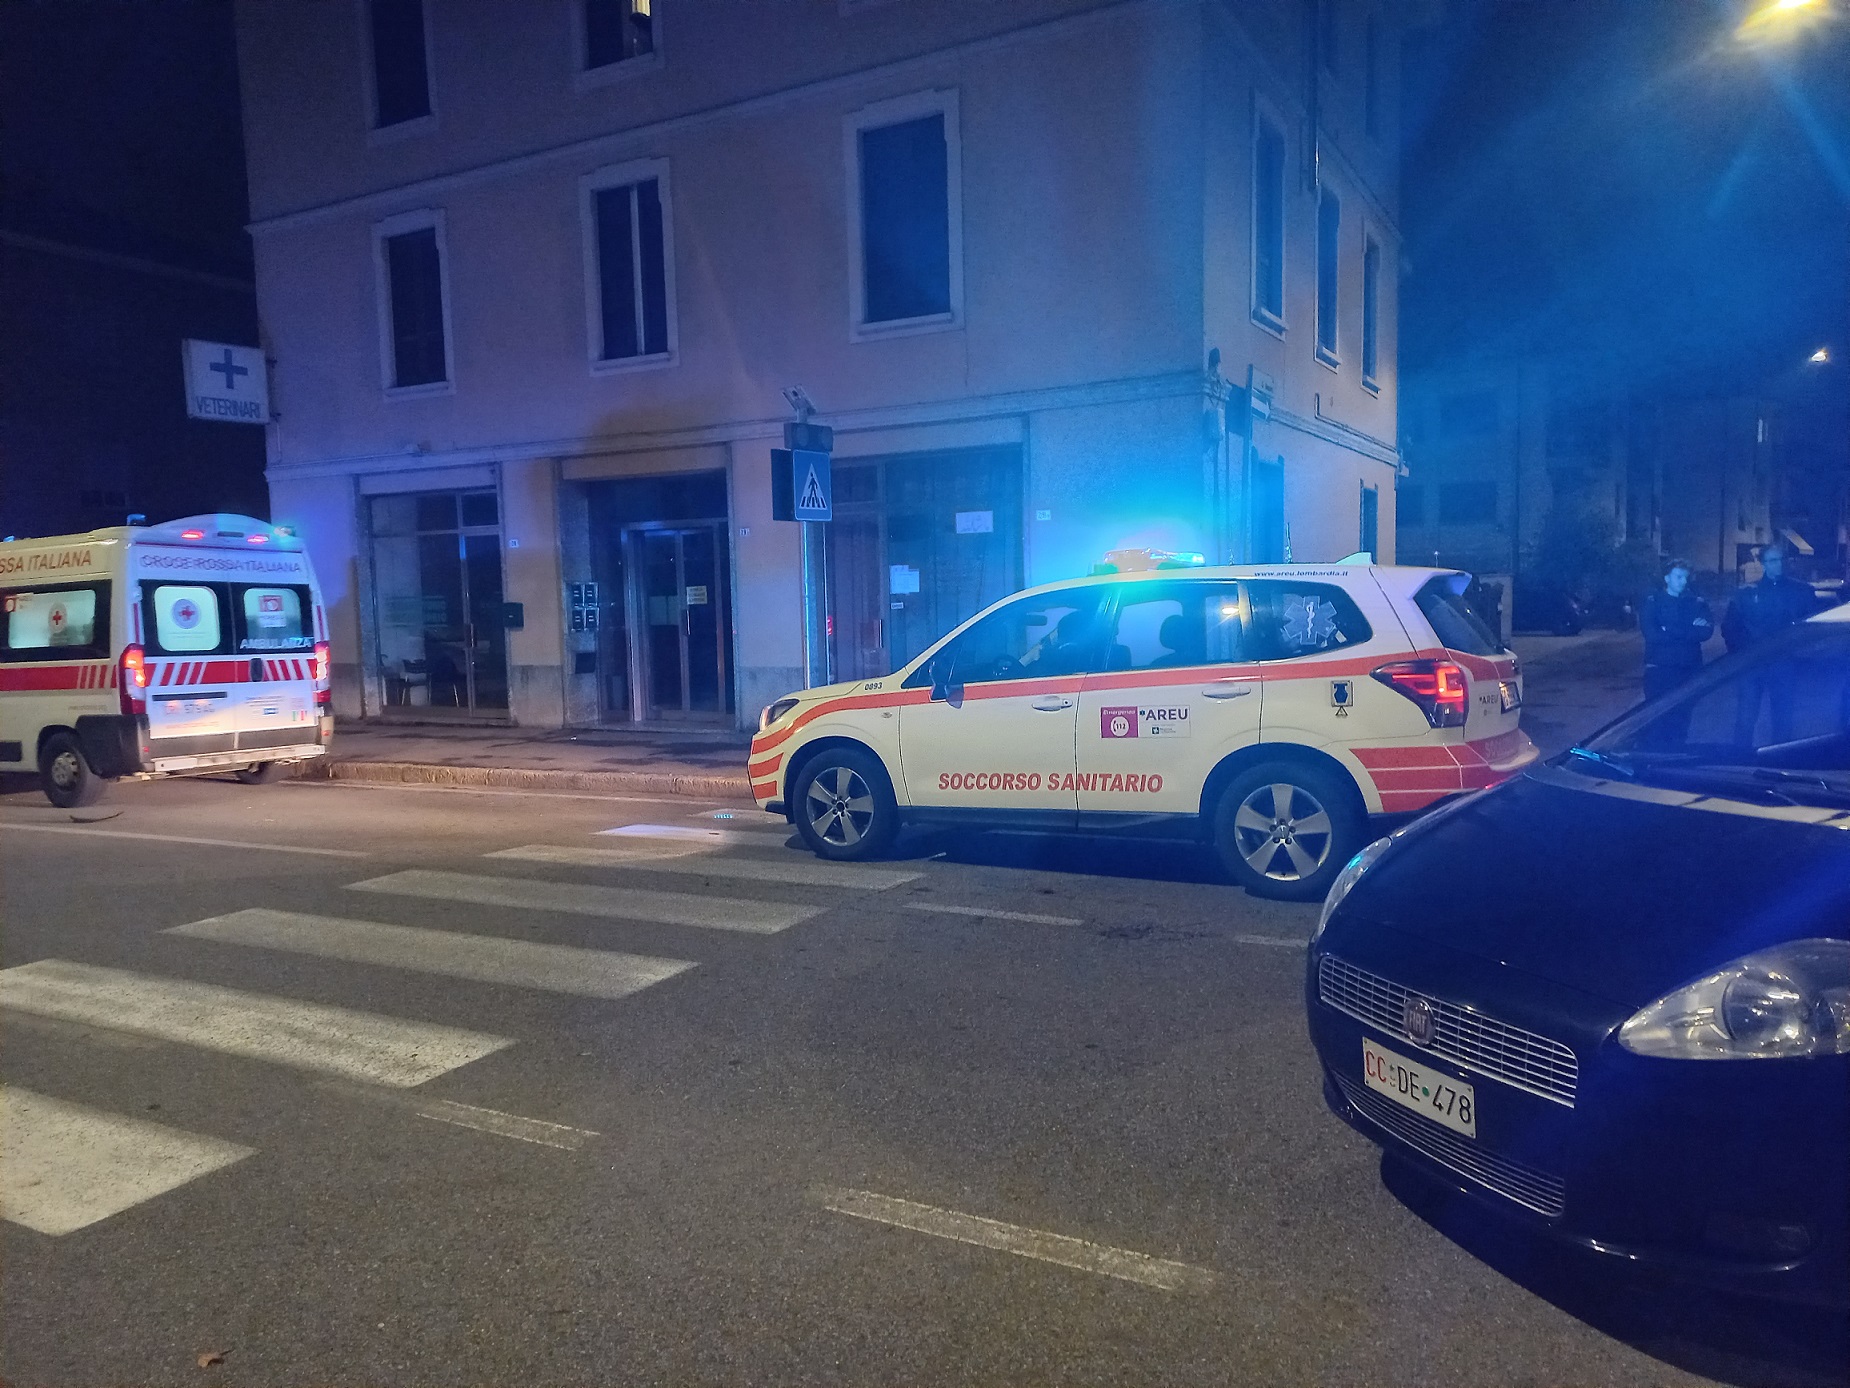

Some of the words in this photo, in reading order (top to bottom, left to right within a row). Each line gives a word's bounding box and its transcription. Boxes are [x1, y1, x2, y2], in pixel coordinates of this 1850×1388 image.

[193, 396, 261, 419] VETERINARI
[27, 550, 92, 571] ITALIANA
[239, 636, 313, 650] AMBULANZA
[864, 681, 883, 691] 0893
[1145, 708, 1188, 721] AREU
[938, 772, 1042, 791] SOCCORSO
[1047, 772, 1163, 793] SANITARIO
[1365, 1050, 1387, 1083] CC
[1397, 1065, 1420, 1102] DE
[1432, 1084, 1472, 1124] 478
